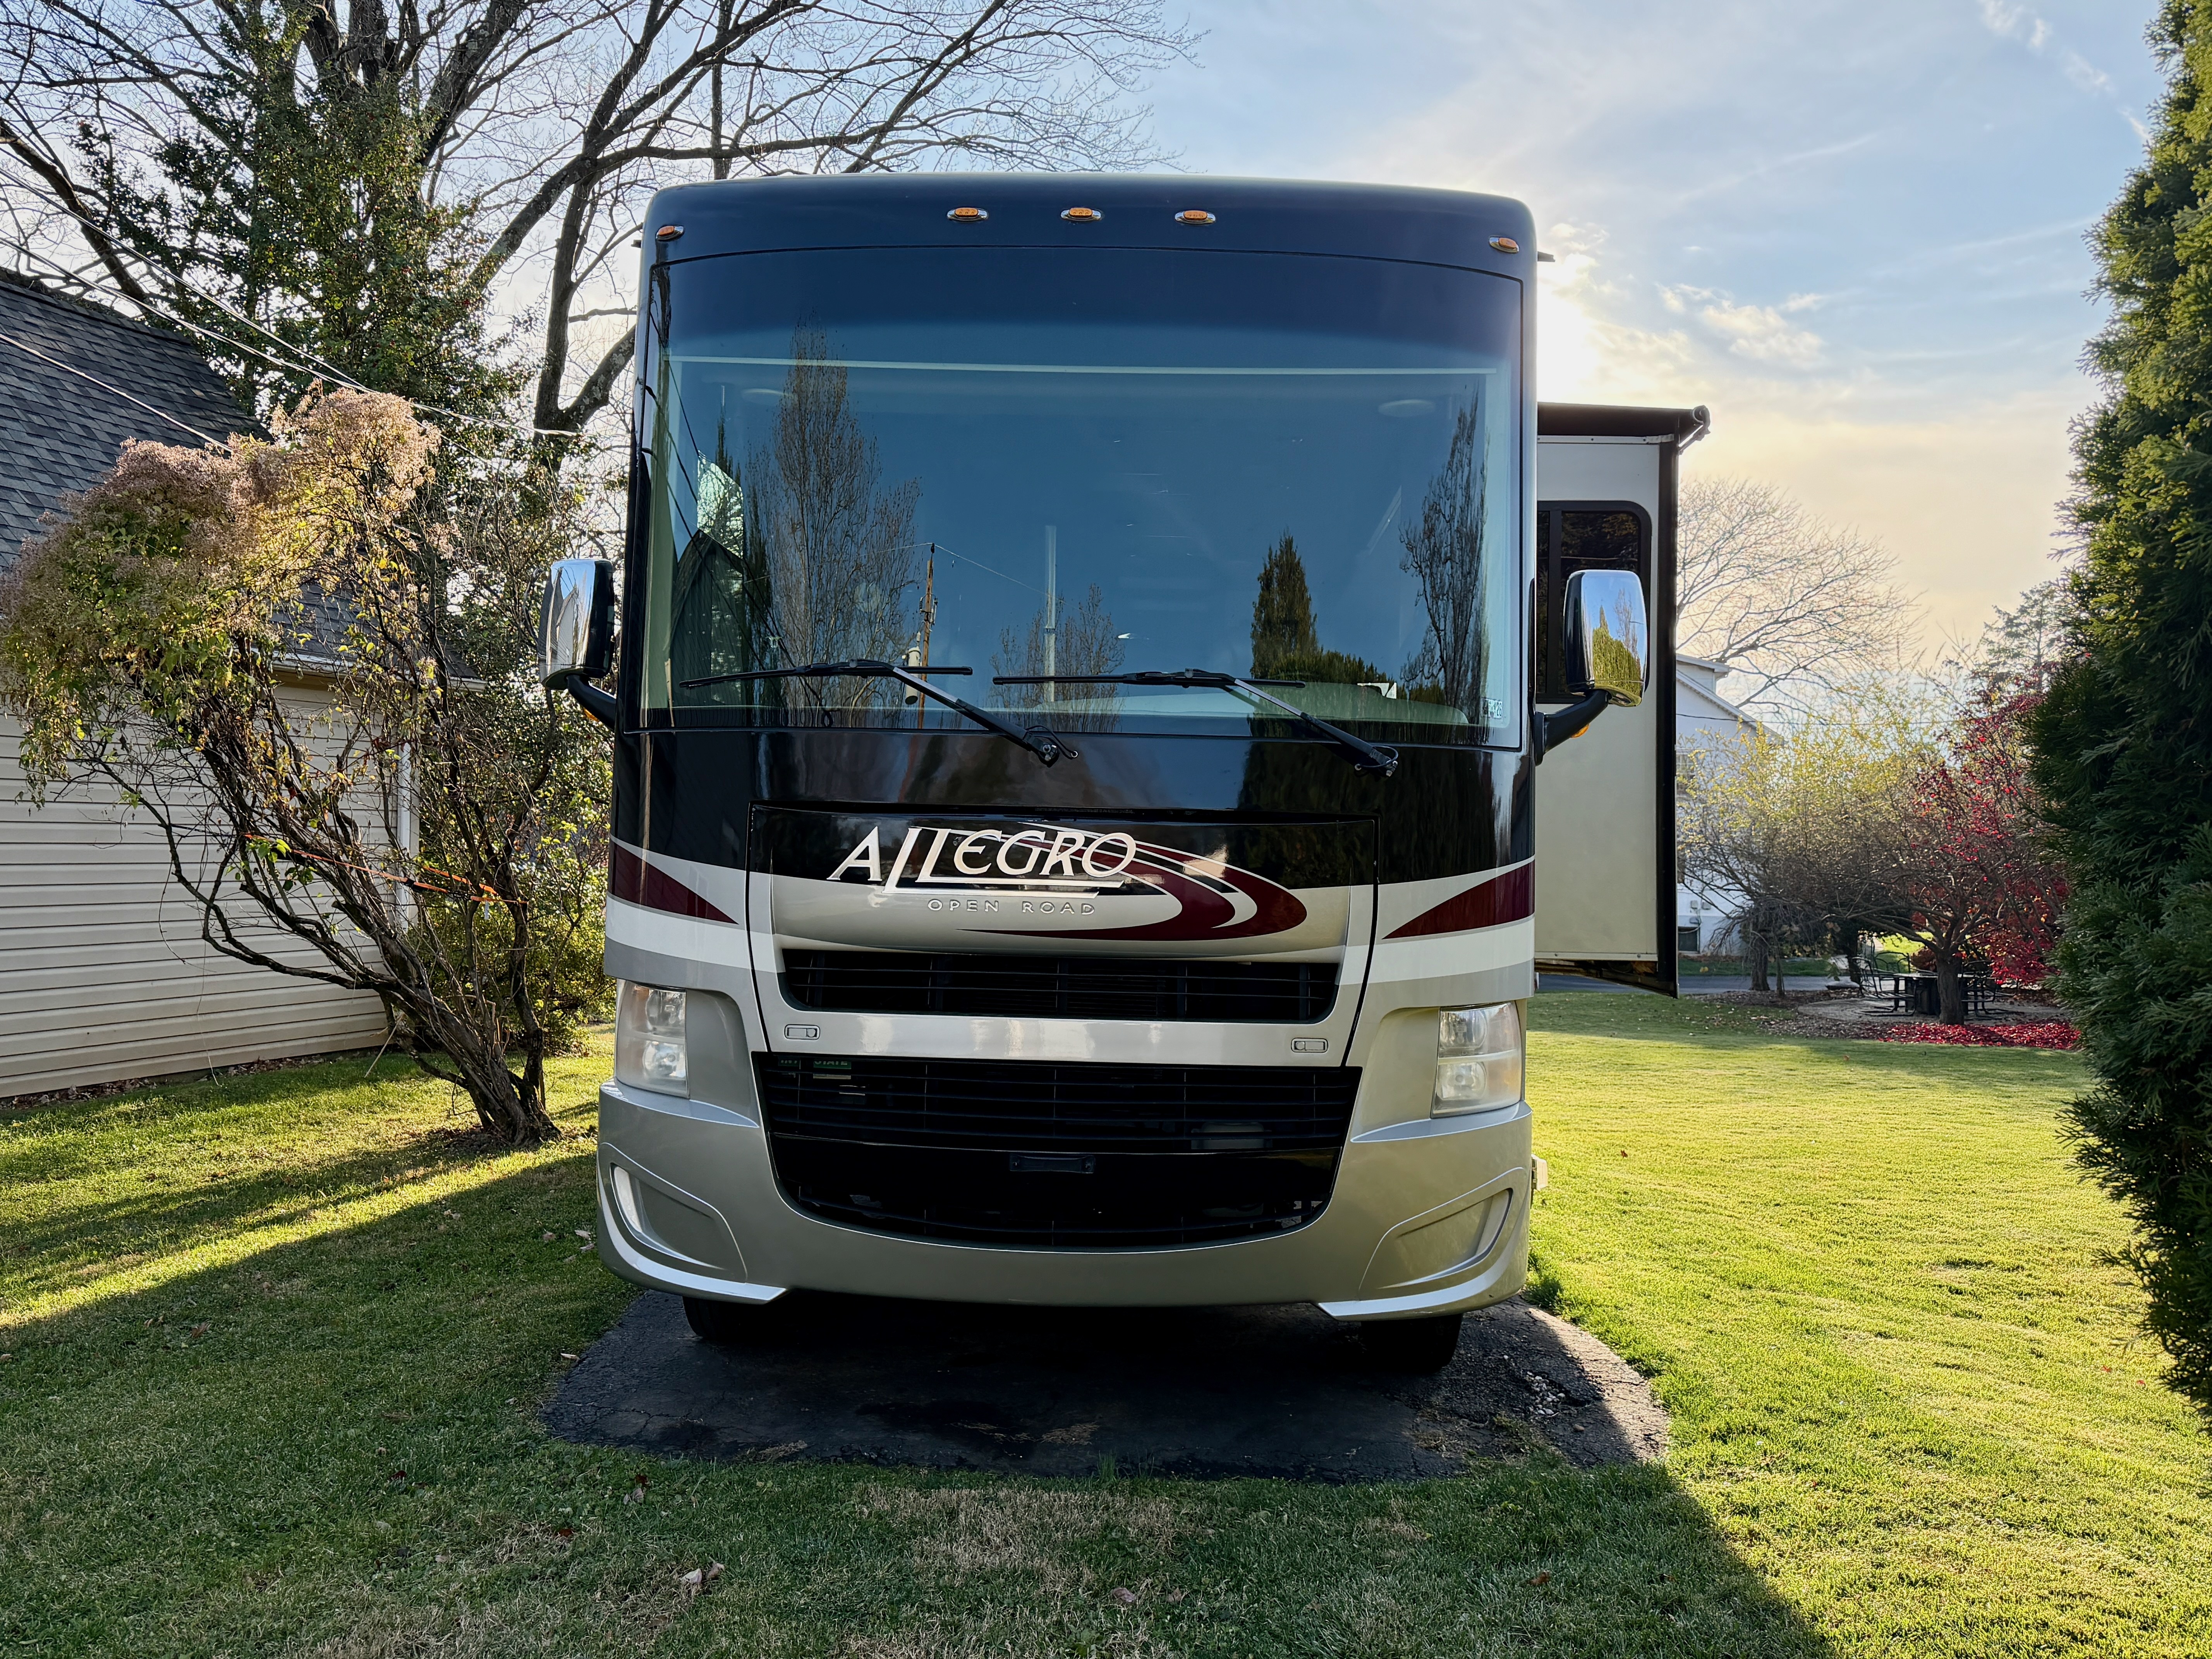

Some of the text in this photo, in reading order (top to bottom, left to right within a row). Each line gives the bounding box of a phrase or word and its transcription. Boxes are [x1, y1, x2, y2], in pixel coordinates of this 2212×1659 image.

[826, 826, 1137, 899] ALLEGRO
[927, 899, 1095, 915] OPEN ROAD
